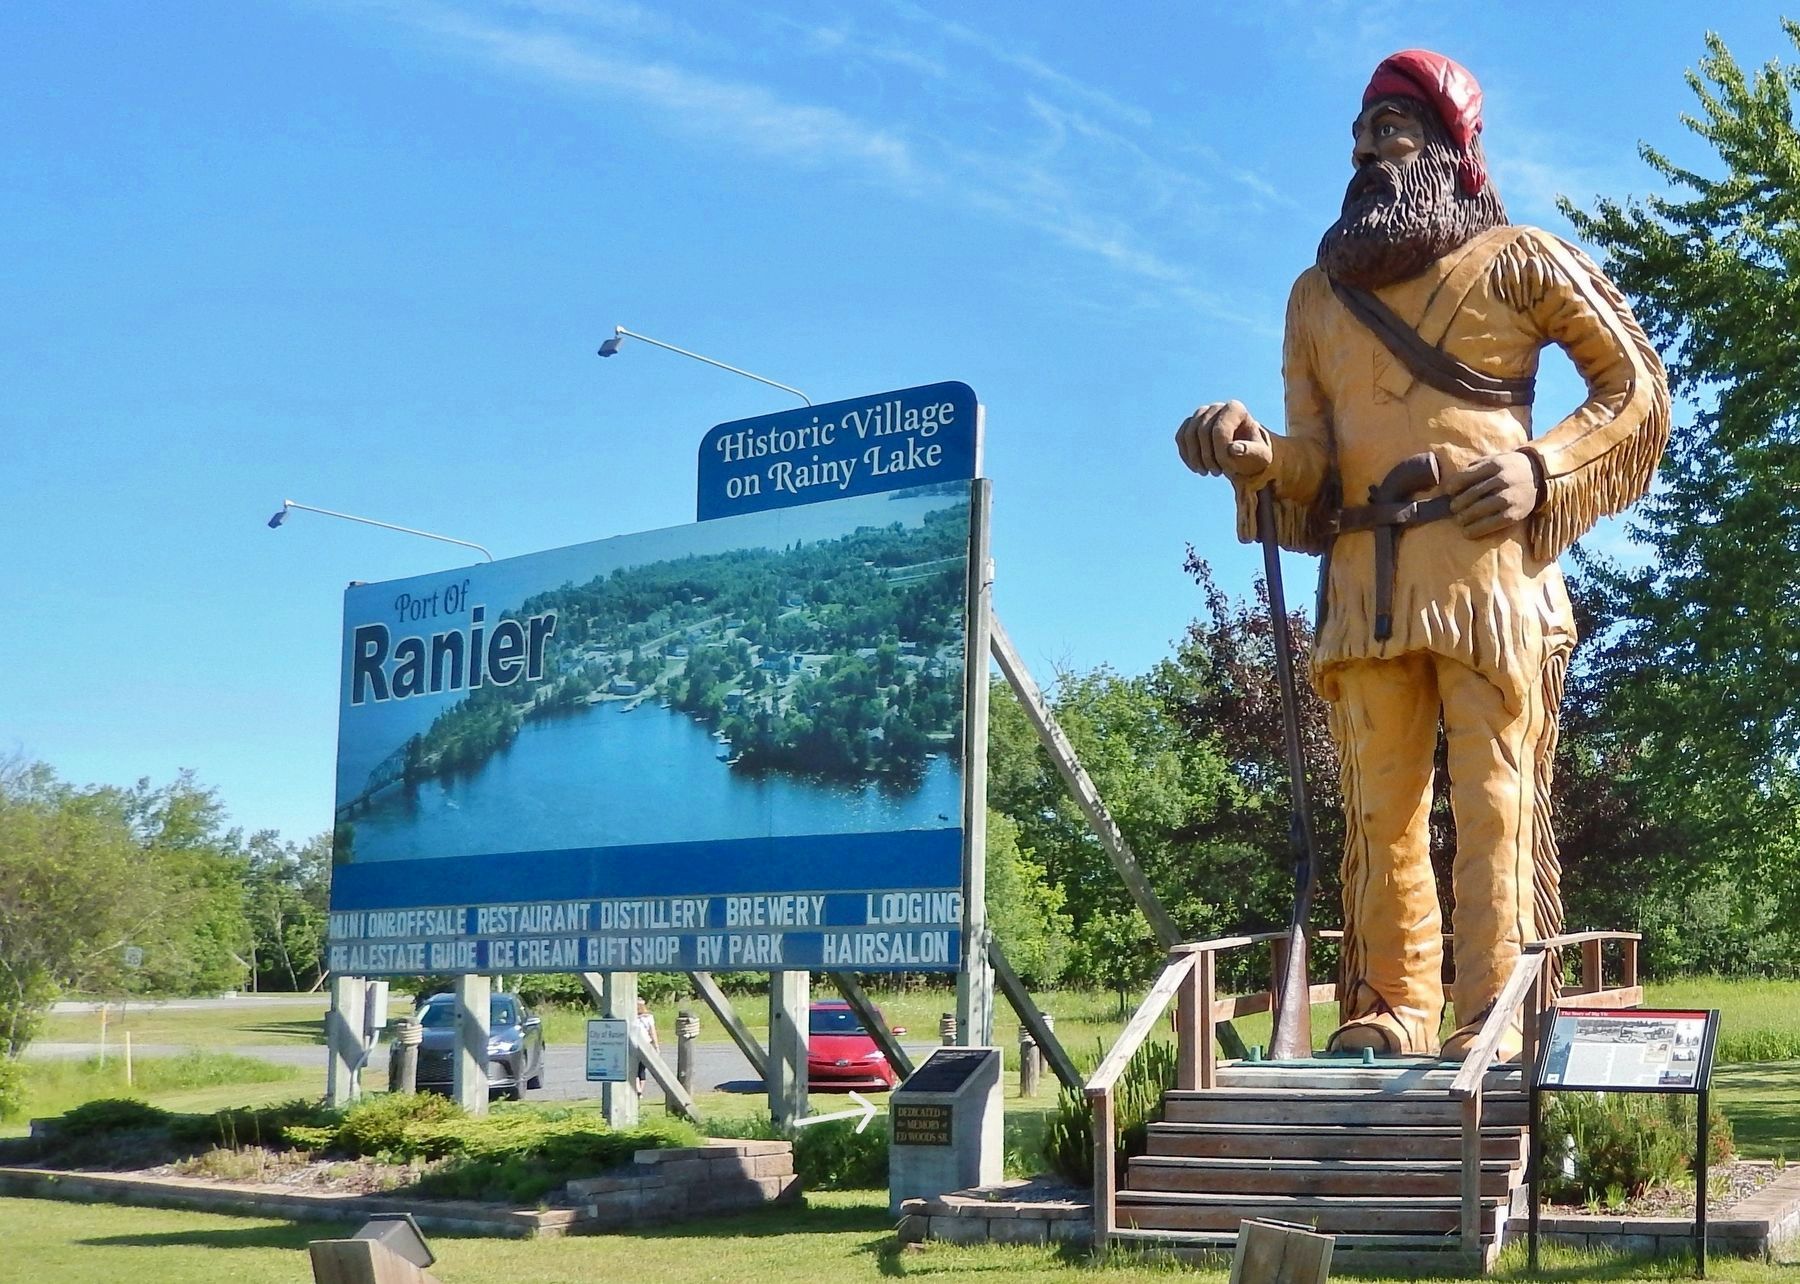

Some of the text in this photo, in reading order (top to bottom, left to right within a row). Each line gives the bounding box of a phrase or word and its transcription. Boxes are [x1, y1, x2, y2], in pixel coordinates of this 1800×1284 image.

[717, 400, 955, 463] Historic Village
[726, 437, 943, 500] on Rainy Lake
[394, 578, 470, 623] Port Of
[351, 603, 558, 706] Ranier
[477, 903, 591, 935] RESTAURANT
[601, 899, 711, 930] DISTILLERY
[726, 895, 825, 929] BREWERY
[866, 892, 961, 925] LODGING
[430, 941, 477, 970] GUIDE
[487, 940, 515, 969] ICE
[518, 938, 579, 968] CREAM
[587, 935, 680, 967] GIFTSHOP
[697, 935, 723, 966] RV
[728, 933, 784, 965] PARK
[823, 931, 950, 965] HAIRSALON
